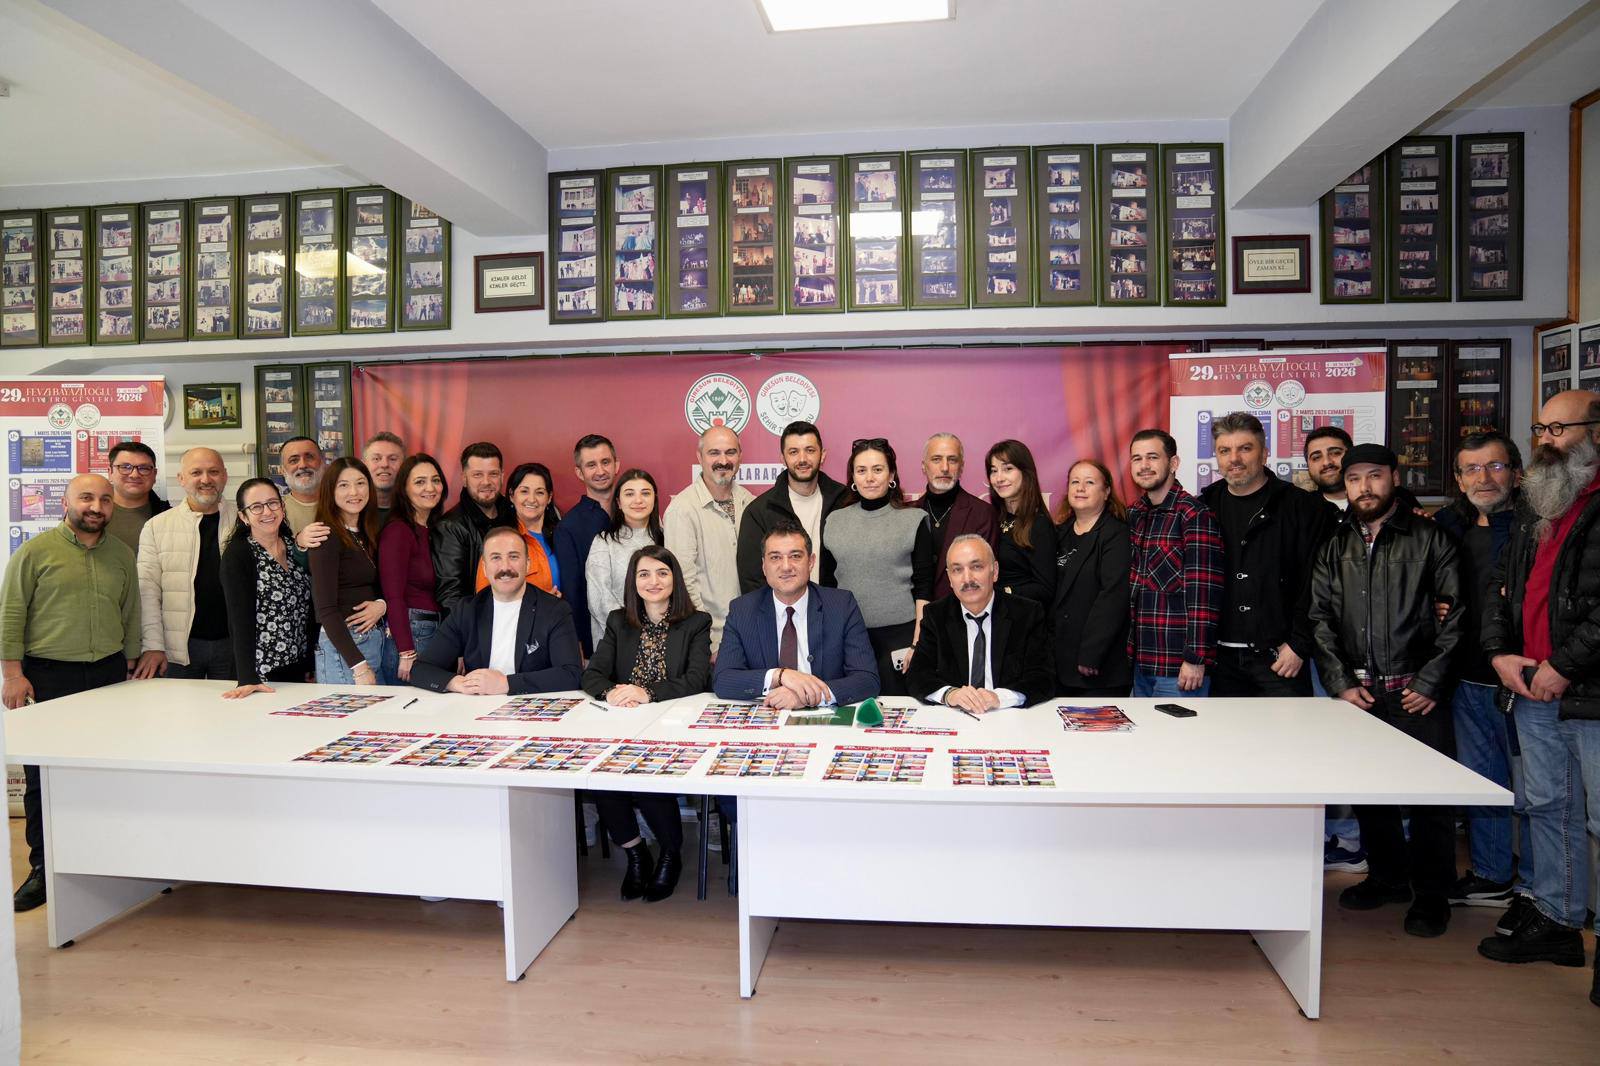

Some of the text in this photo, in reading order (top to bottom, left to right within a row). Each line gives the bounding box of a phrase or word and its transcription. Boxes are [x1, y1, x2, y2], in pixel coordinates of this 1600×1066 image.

[1189, 365, 1218, 381] 29.
[1325, 367, 1356, 377] 2026
[0, 388, 26, 403] 29.
